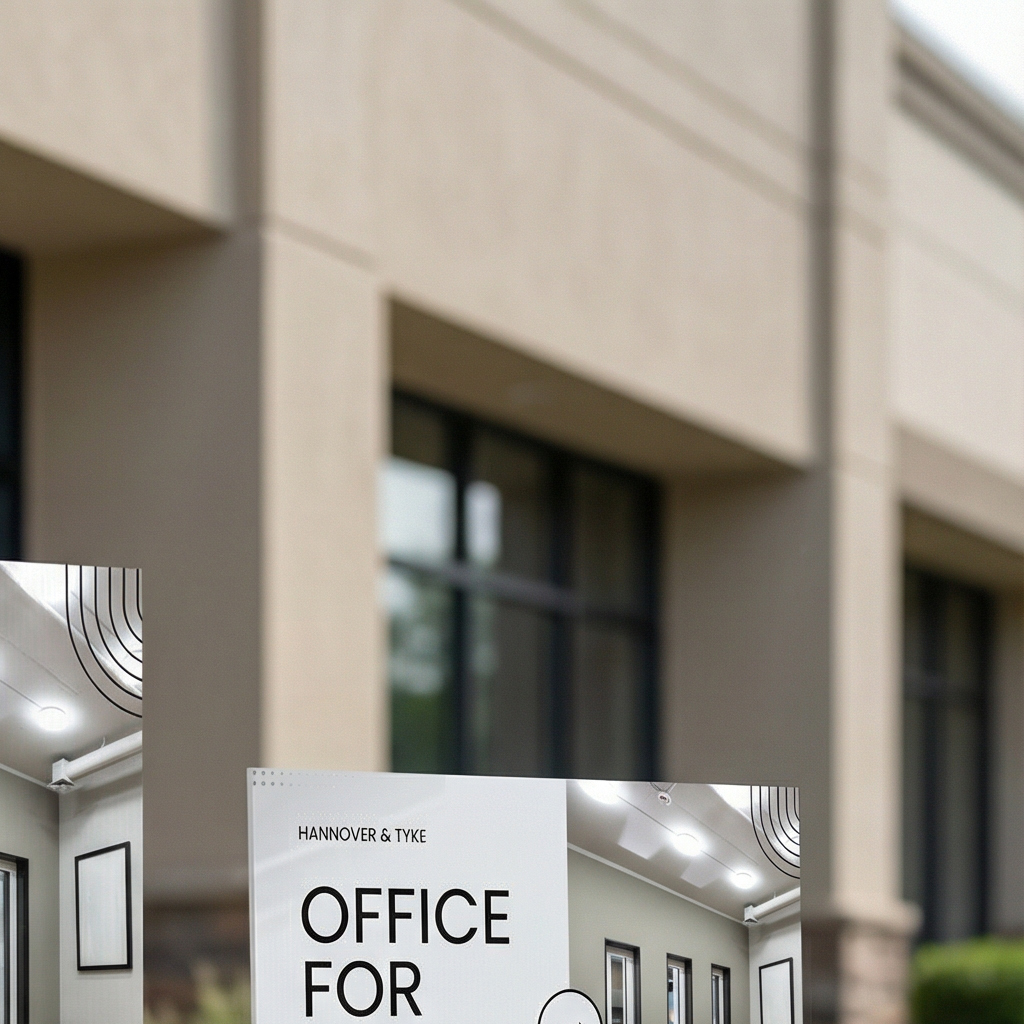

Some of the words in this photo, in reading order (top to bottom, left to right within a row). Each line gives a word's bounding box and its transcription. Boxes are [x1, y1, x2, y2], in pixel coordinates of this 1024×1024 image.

[298, 825, 377, 843] HANNOVER
[380, 827, 392, 843] &
[394, 828, 427, 844] TYKE
[301, 885, 510, 945] OFFICE
[304, 960, 423, 1018] FOR
